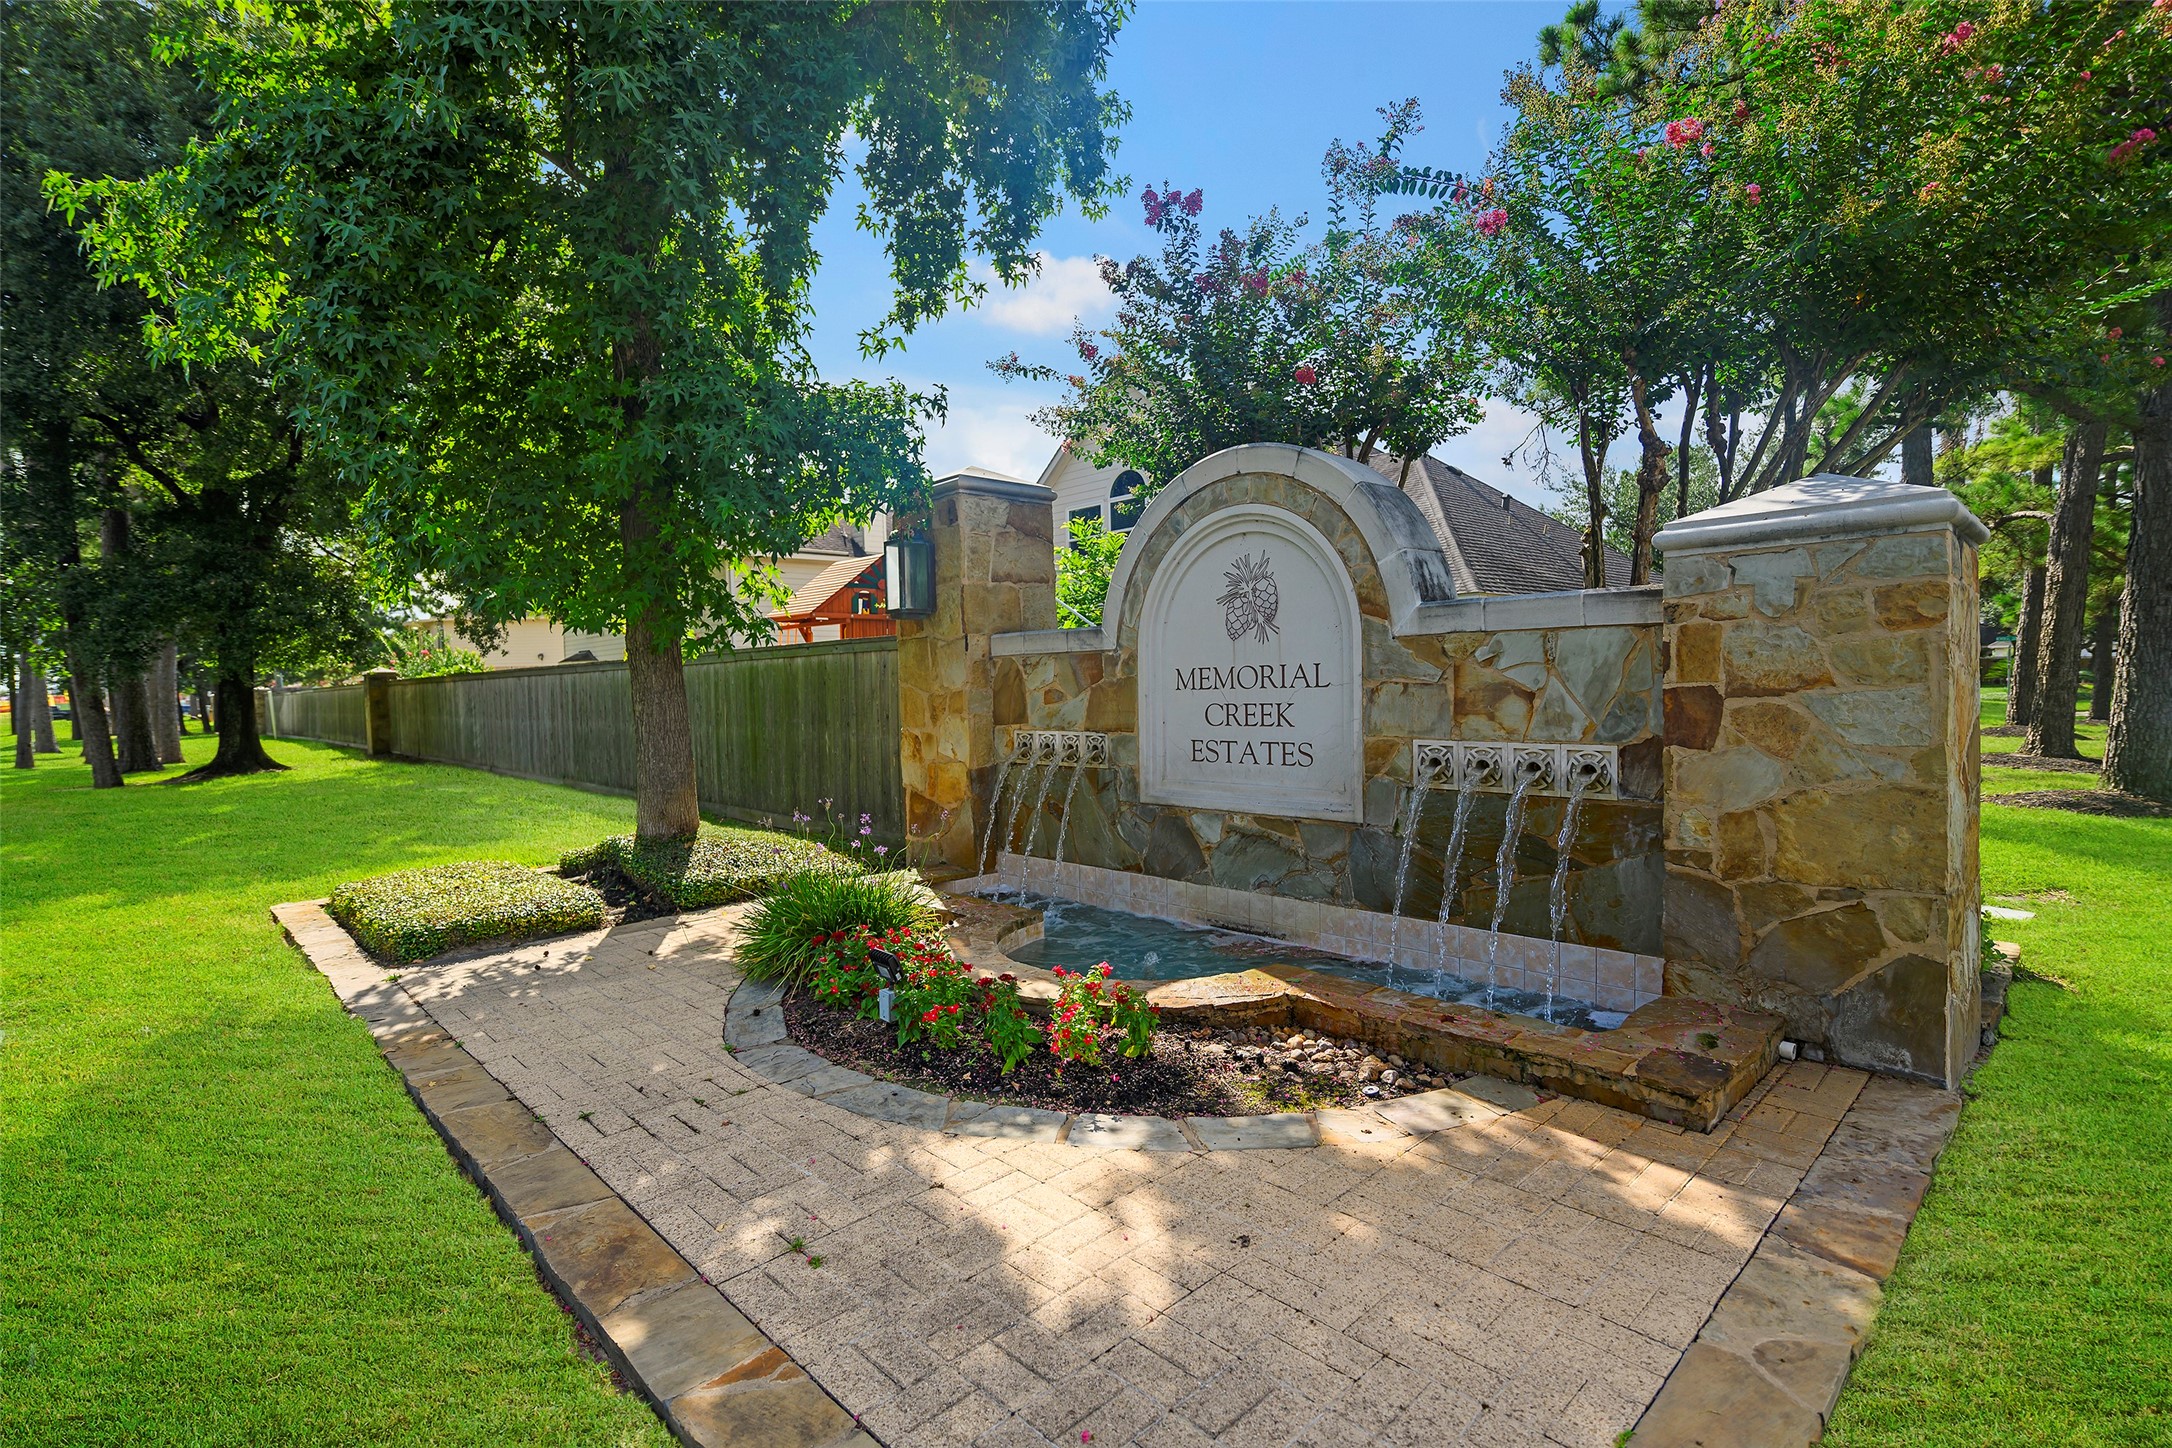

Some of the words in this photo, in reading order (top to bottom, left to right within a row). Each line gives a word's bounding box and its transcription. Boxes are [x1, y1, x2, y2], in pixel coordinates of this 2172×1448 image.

[1175, 663, 1331, 690] MEMORIAL
[1204, 702, 1295, 728] CREEK
[1190, 739, 1314, 768] ESTATES
